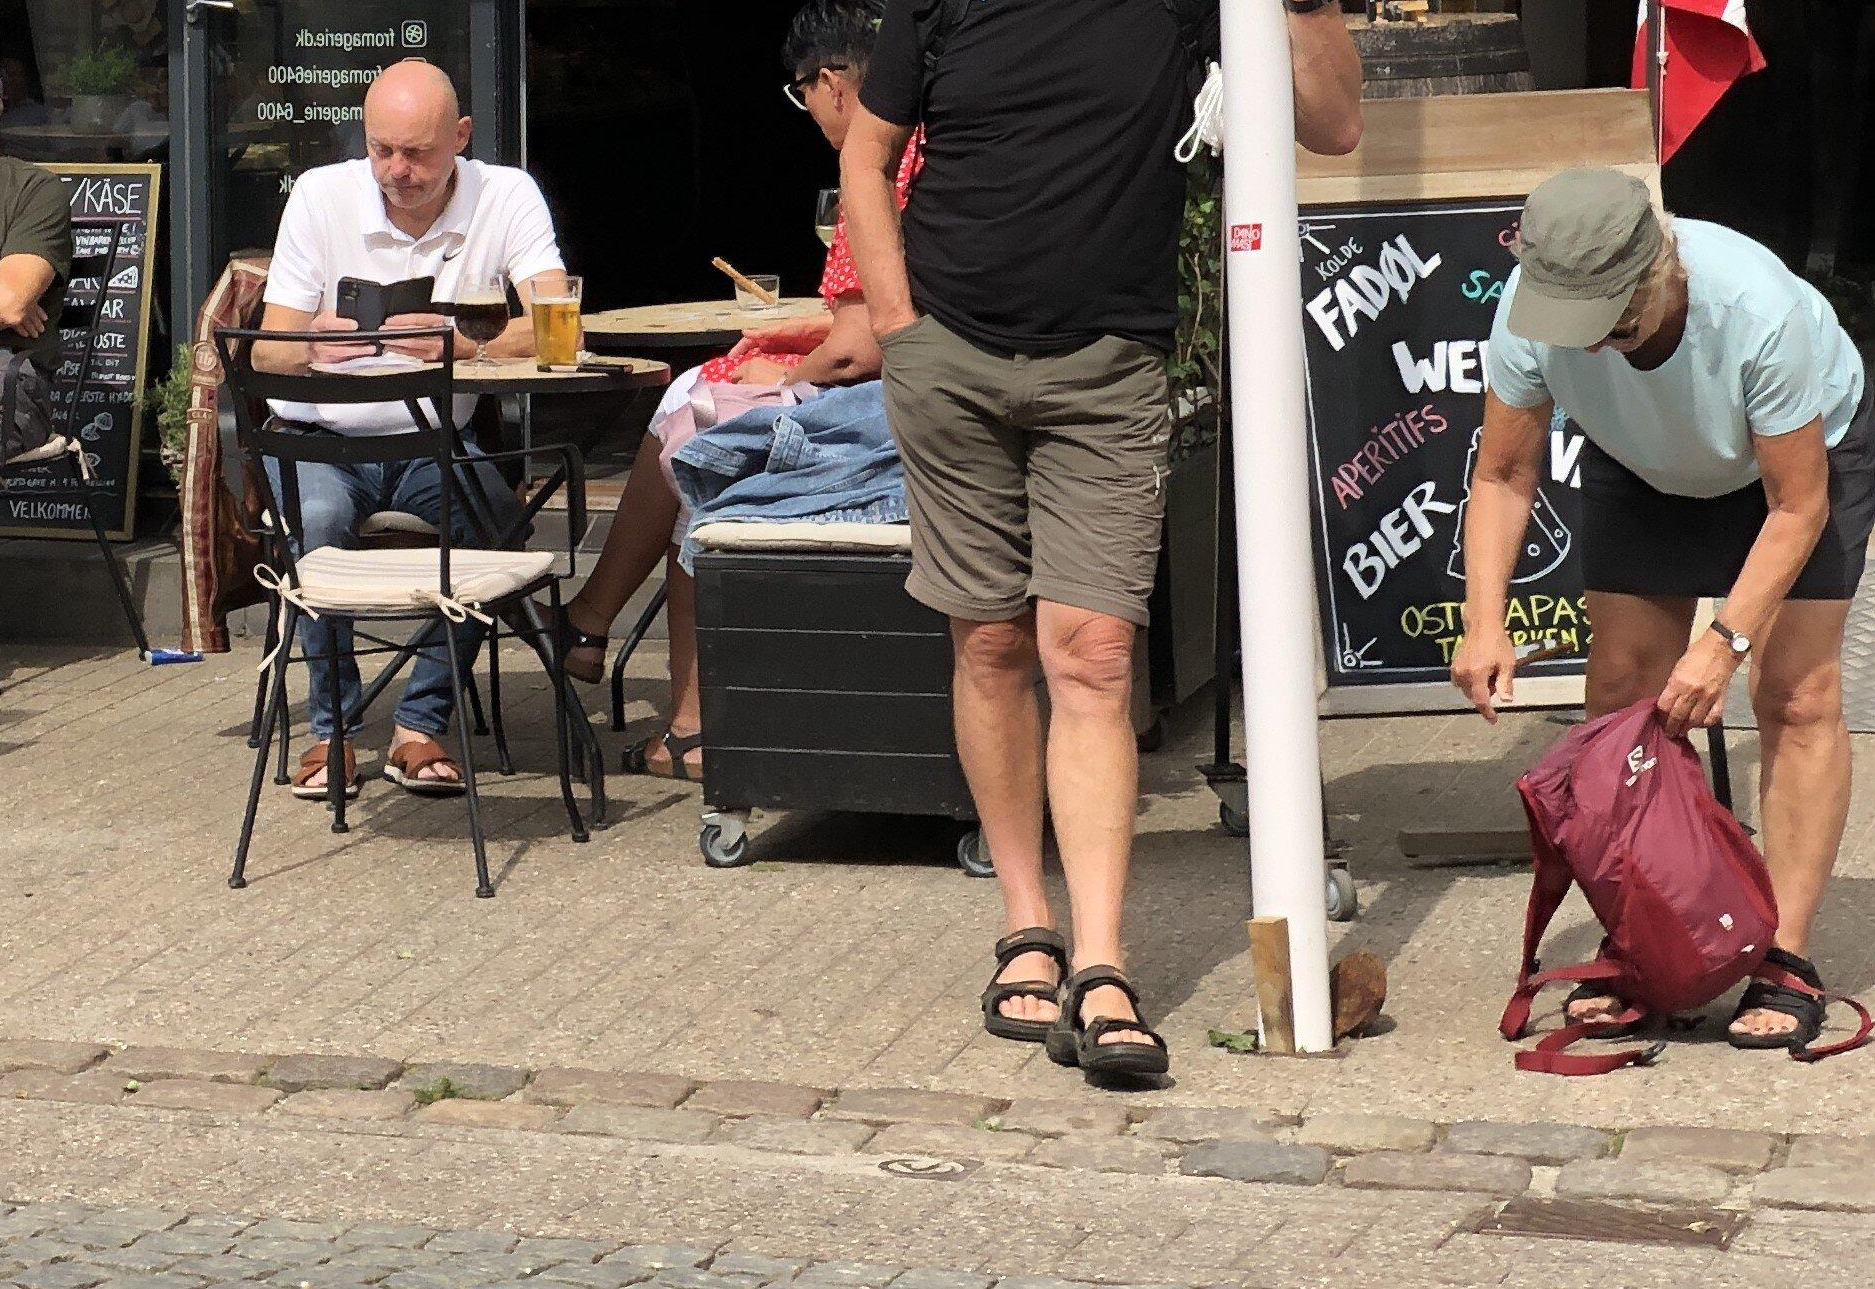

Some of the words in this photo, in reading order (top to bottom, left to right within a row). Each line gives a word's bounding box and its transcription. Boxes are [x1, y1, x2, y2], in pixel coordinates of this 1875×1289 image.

[61, 177, 143, 215] /KÄSE
[1306, 233, 1442, 352] FADØL
[1315, 236, 1364, 282] KOLDE
[1342, 480, 1458, 601] BIER
